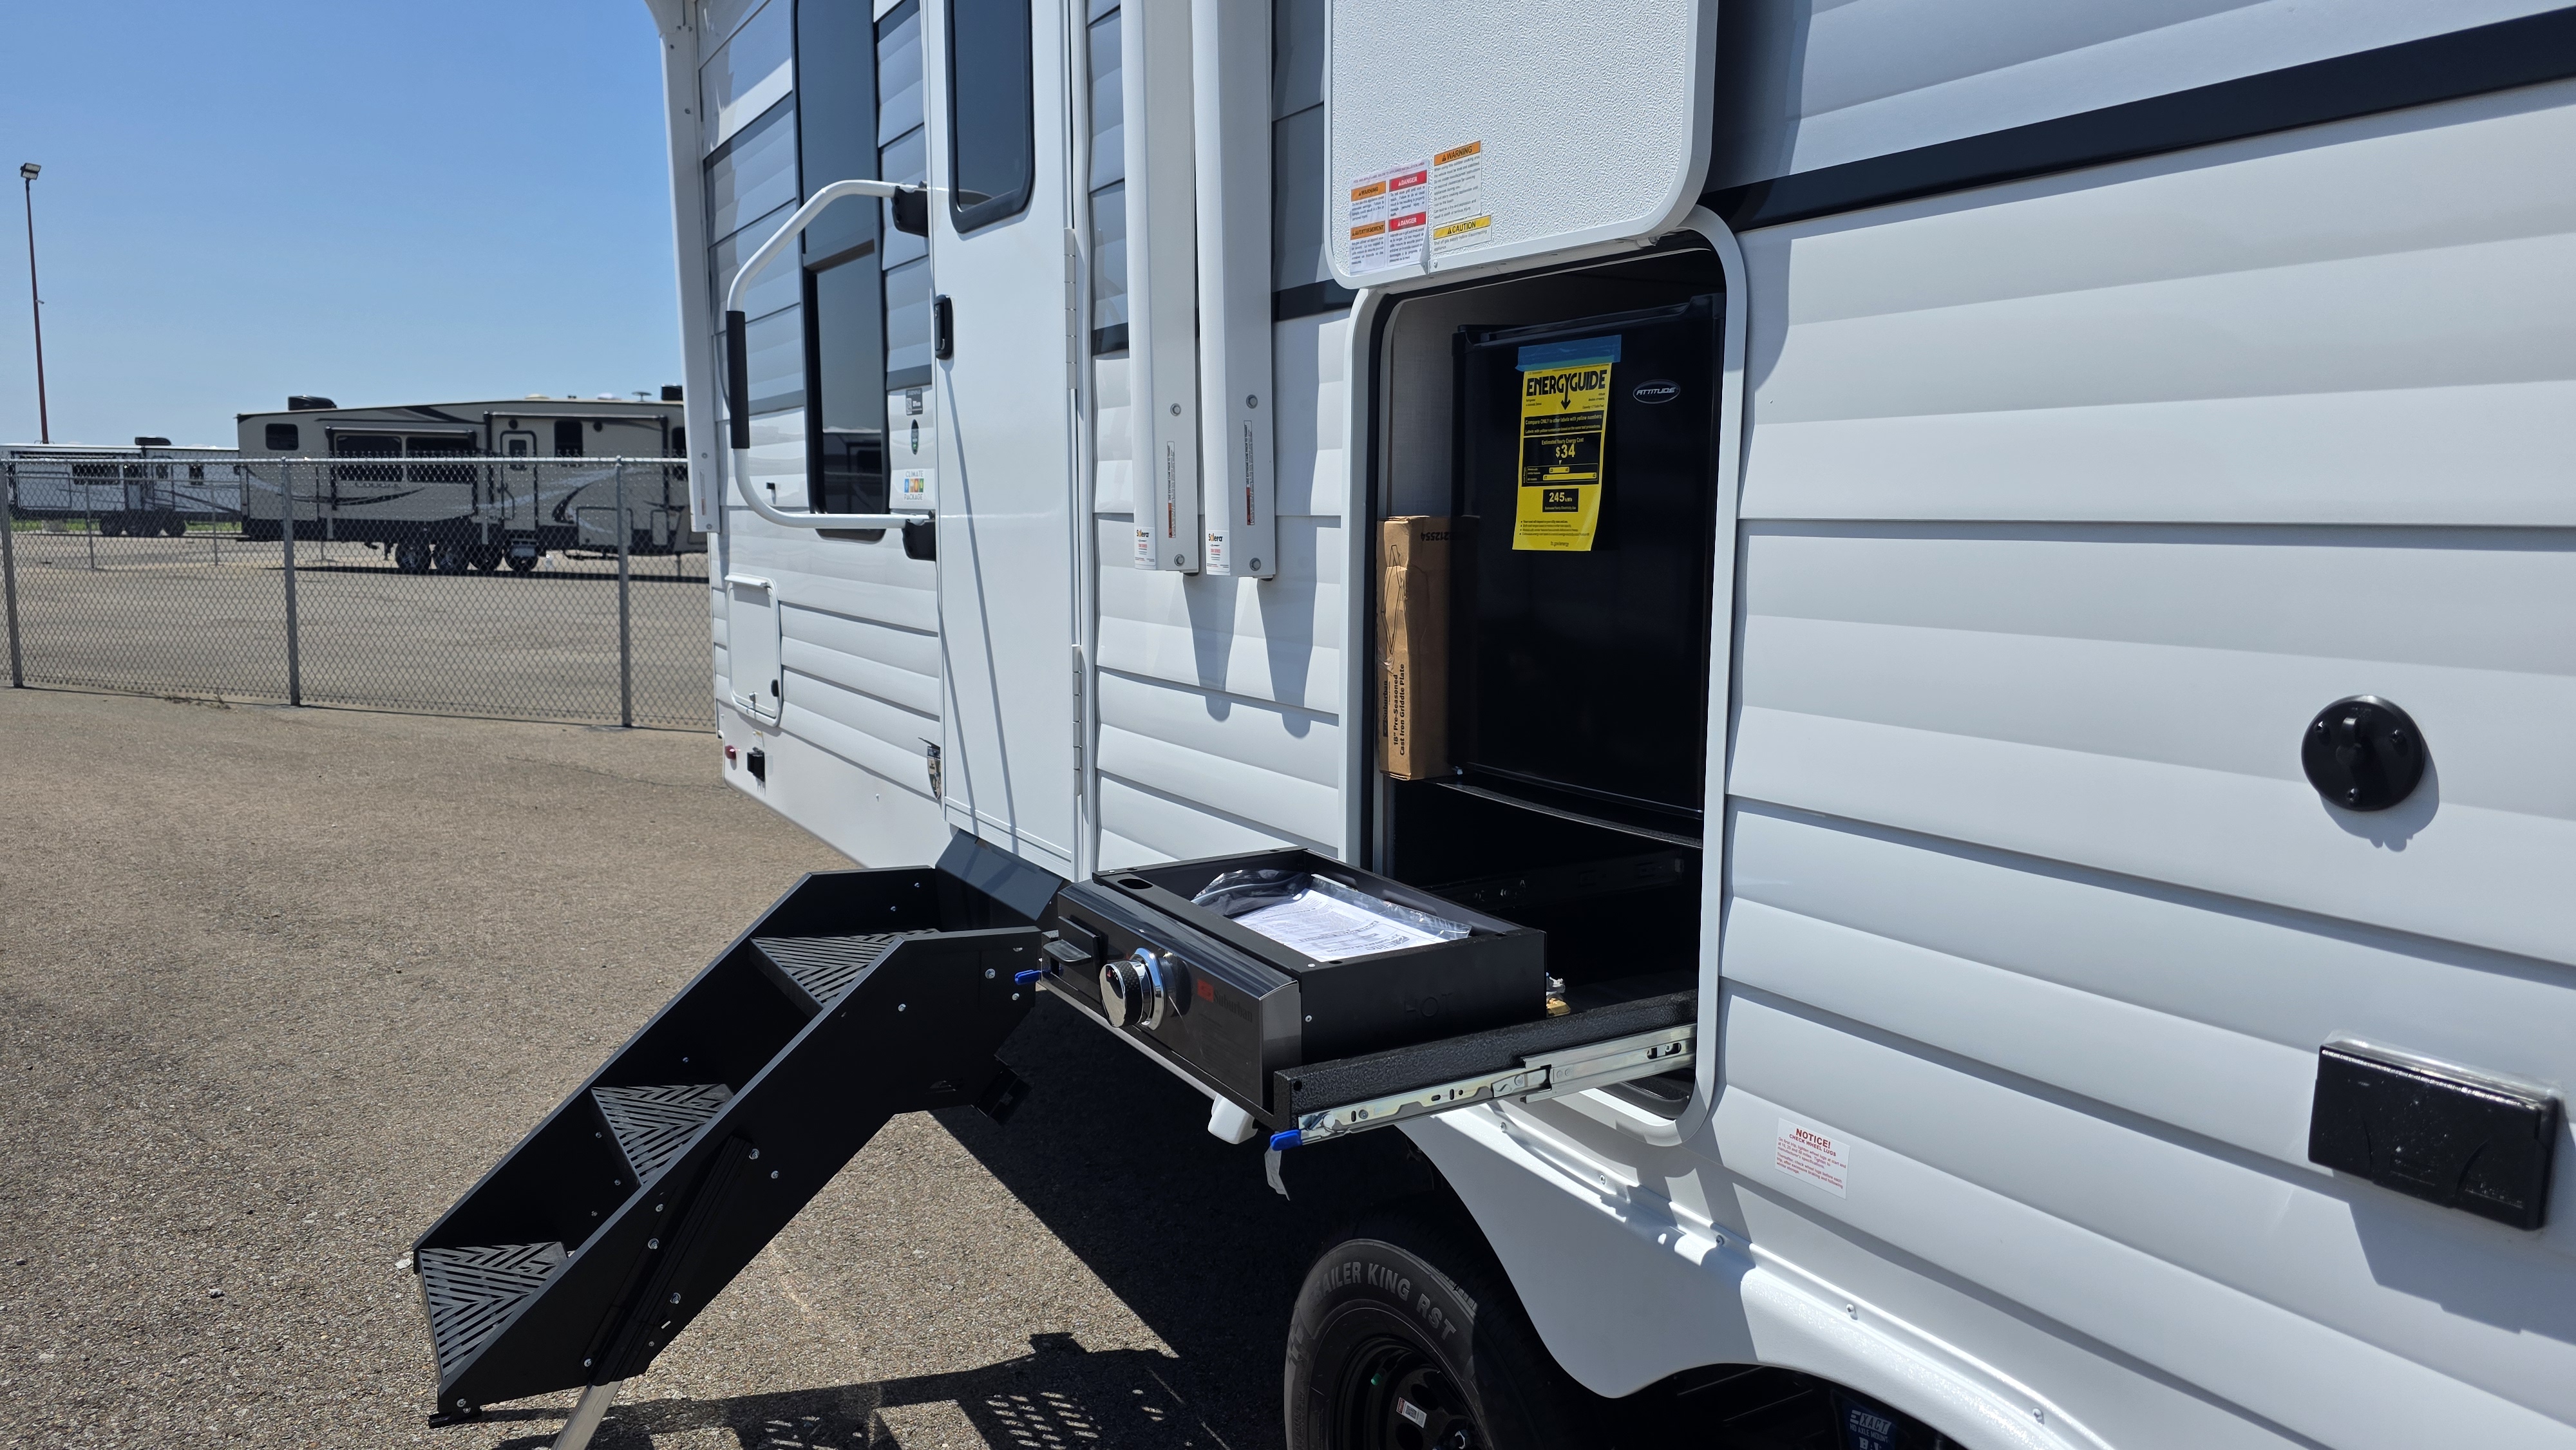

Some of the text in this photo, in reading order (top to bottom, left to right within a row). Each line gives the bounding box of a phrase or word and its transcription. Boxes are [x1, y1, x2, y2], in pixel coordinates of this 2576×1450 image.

[1446, 146, 1472, 161] WARNING
[1452, 221, 1475, 233] CAUTION
[1526, 370, 1607, 396] ENERGYGUIDE
[1636, 387, 1676, 395] ATTITUDE
[1556, 444, 1575, 458] $34
[1549, 493, 1564, 502] 245
[1208, 533, 1223, 541] Solera
[1421, 532, 1455, 541] 212554
[1214, 990, 1253, 1023] Suburban
[1790, 1134, 1836, 1156] CHECK WHEEL LUGS
[1796, 1129, 1830, 1149] NOTICE!
[1814, 1157, 1826, 1165] Tighten
[1808, 1171, 1820, 1179] braking
[1368, 1263, 1411, 1301] KING
[1416, 1293, 1457, 1341] RST
[1857, 1427, 1870, 1437] AXLE
[1870, 1431, 1888, 1444] MOUNT
